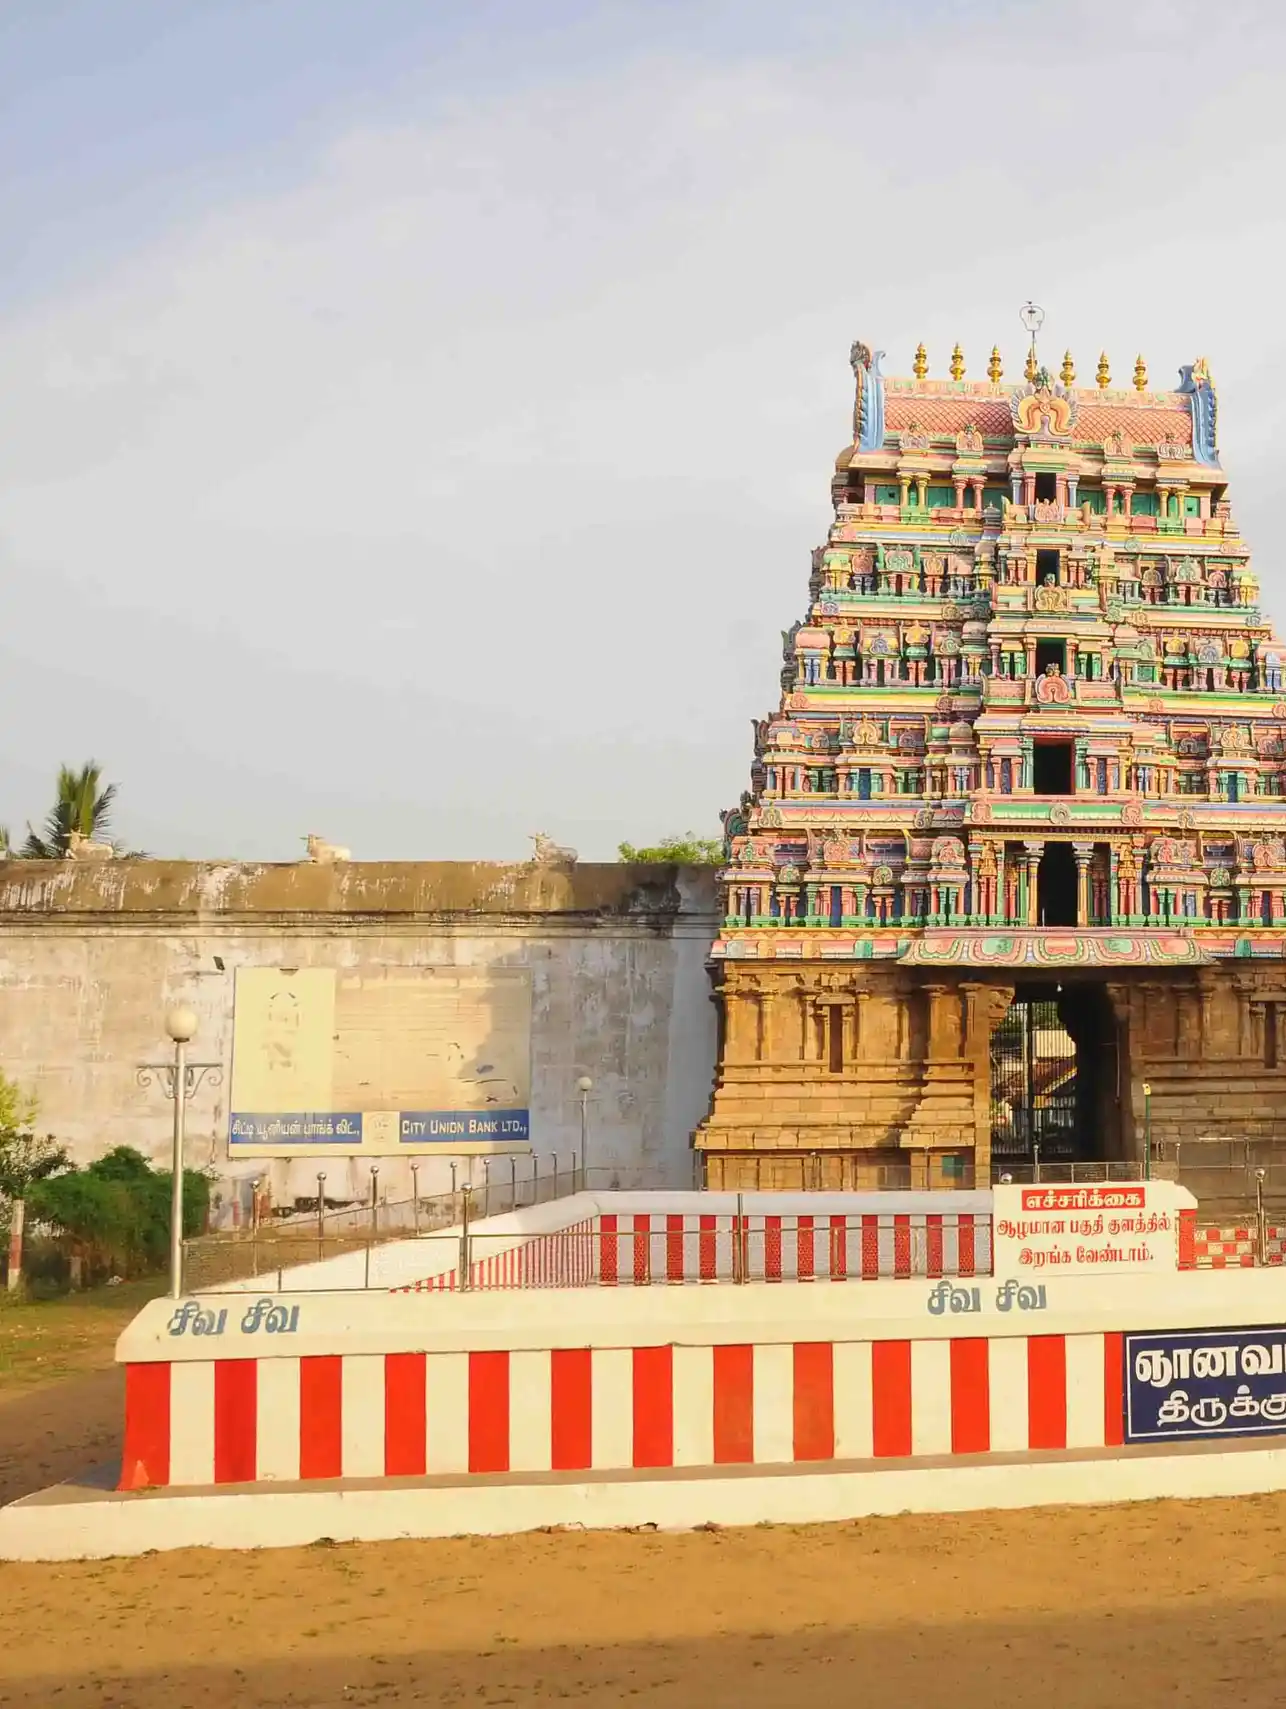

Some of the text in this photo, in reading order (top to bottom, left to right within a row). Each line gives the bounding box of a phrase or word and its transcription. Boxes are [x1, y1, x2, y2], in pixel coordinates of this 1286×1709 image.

[402, 1120, 425, 1134] CITY
[430, 1119, 465, 1134] UNION
[468, 1119, 498, 1134] BANK
[1026, 1189, 1141, 1209] எச்சரிக்கை
[997, 1212, 1171, 1240] ஆழமான பகுதி குளத்தில்
[1018, 1242, 1154, 1269] இறங்க வேண்டாம்.
[927, 1278, 1047, 1315] சிவ சிவ
[167, 1298, 300, 1336] சிவ சிவ
